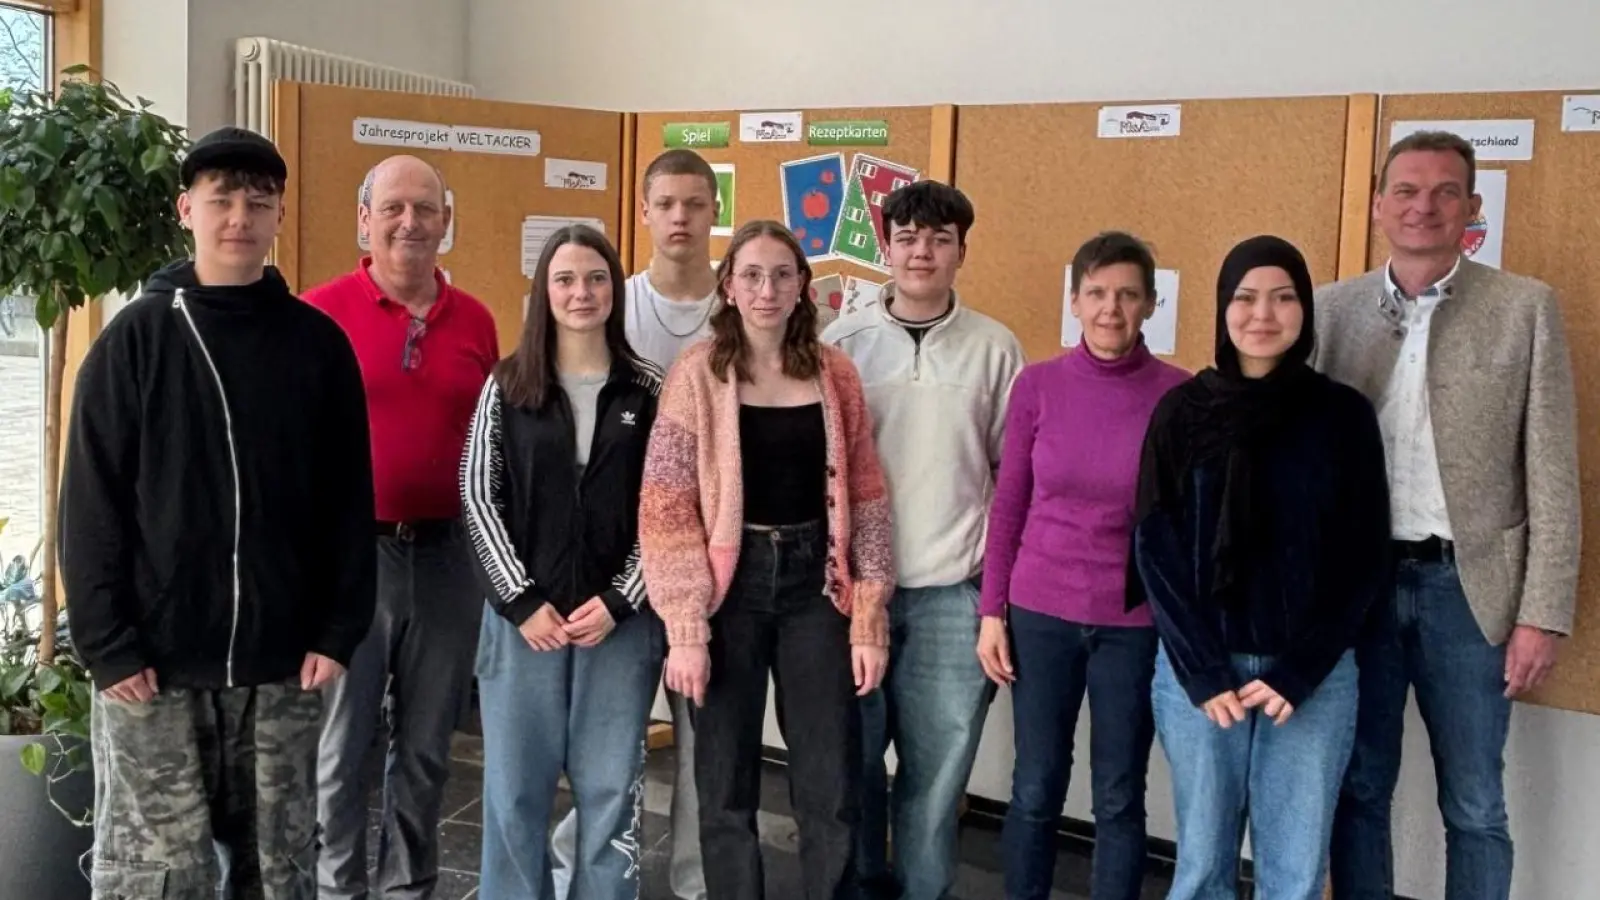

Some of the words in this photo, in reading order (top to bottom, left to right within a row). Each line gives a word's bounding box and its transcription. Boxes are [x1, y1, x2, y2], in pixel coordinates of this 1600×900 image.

[359, 123, 449, 144] Jahresprojekt
[457, 132, 532, 149] WELTACKER
[682, 128, 711, 144] Spiel
[809, 123, 887, 141] Rezeptkarten
[1470, 135, 1519, 147] tschland
